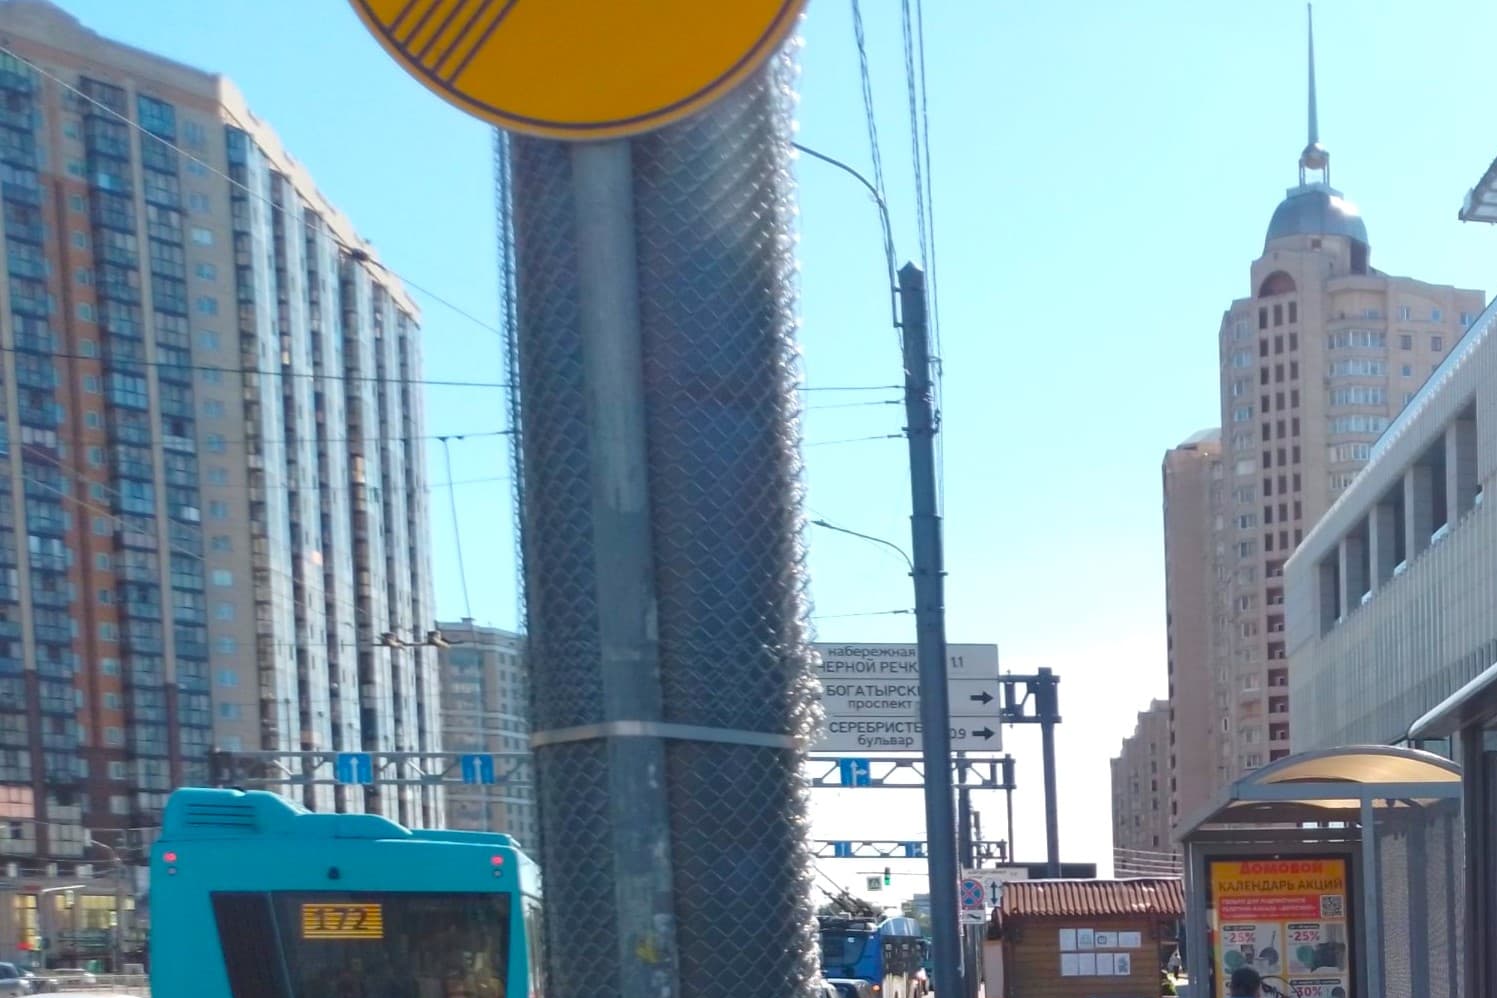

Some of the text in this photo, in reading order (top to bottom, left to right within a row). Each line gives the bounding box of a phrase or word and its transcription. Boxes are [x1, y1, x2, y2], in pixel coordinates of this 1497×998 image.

[828, 645, 916, 659] набережная
[880, 661, 920, 673] РЕЧК
[826, 685, 921, 697] БОГАТЫРСК
[848, 700, 912, 711] проспект
[857, 734, 914, 747] бульвар
[1218, 881, 1294, 892] КАЛЕНДАРЬ
[313, 907, 369, 931] 172
[1288, 931, 1320, 941] -25%
